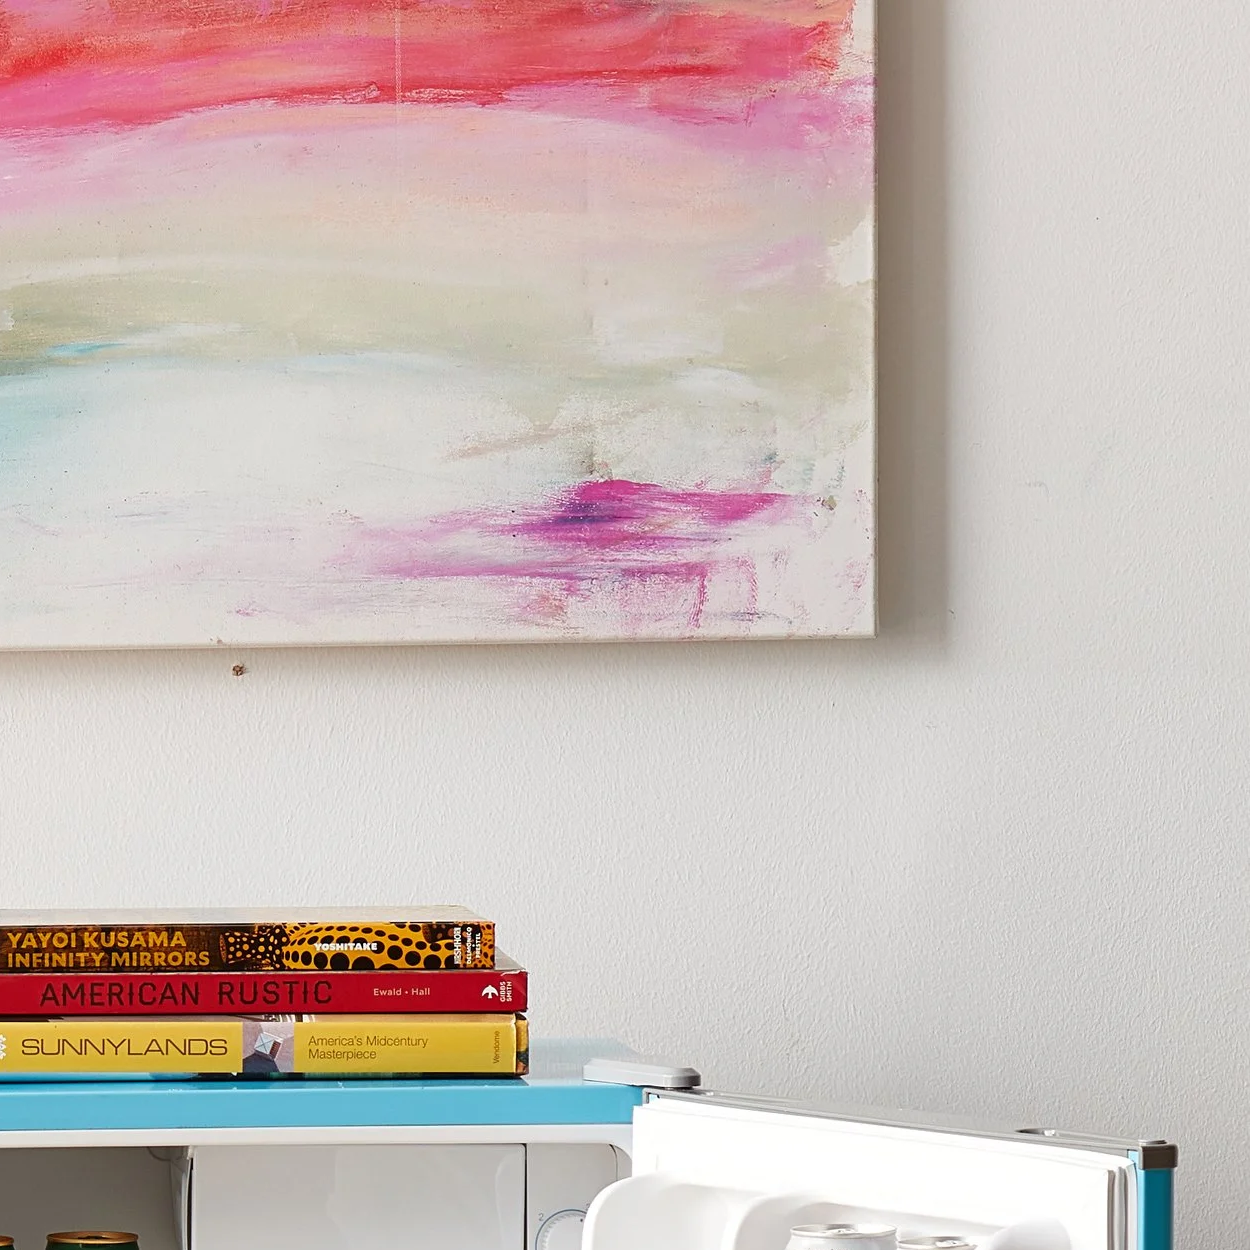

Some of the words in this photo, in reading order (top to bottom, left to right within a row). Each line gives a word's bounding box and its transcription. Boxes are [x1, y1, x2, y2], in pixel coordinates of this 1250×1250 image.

[7, 931, 77, 948] YAYOI
[83, 931, 187, 948] KUSAMA
[314, 942, 378, 951] YOSHITAKE
[7, 952, 105, 968] INFINITY
[111, 951, 210, 967] MIRRORS
[40, 982, 200, 1007] AMERICAN
[217, 980, 332, 1005] RUSTIC
[373, 986, 402, 996] Ewald
[411, 986, 431, 996] Hall
[21, 1038, 228, 1056] SUNNYLANDS
[308, 1035, 363, 1046] America's
[366, 1035, 429, 1049] Midcentury
[308, 1048, 377, 1062] Masterpiece
[538, 1213, 545, 1222] 2
